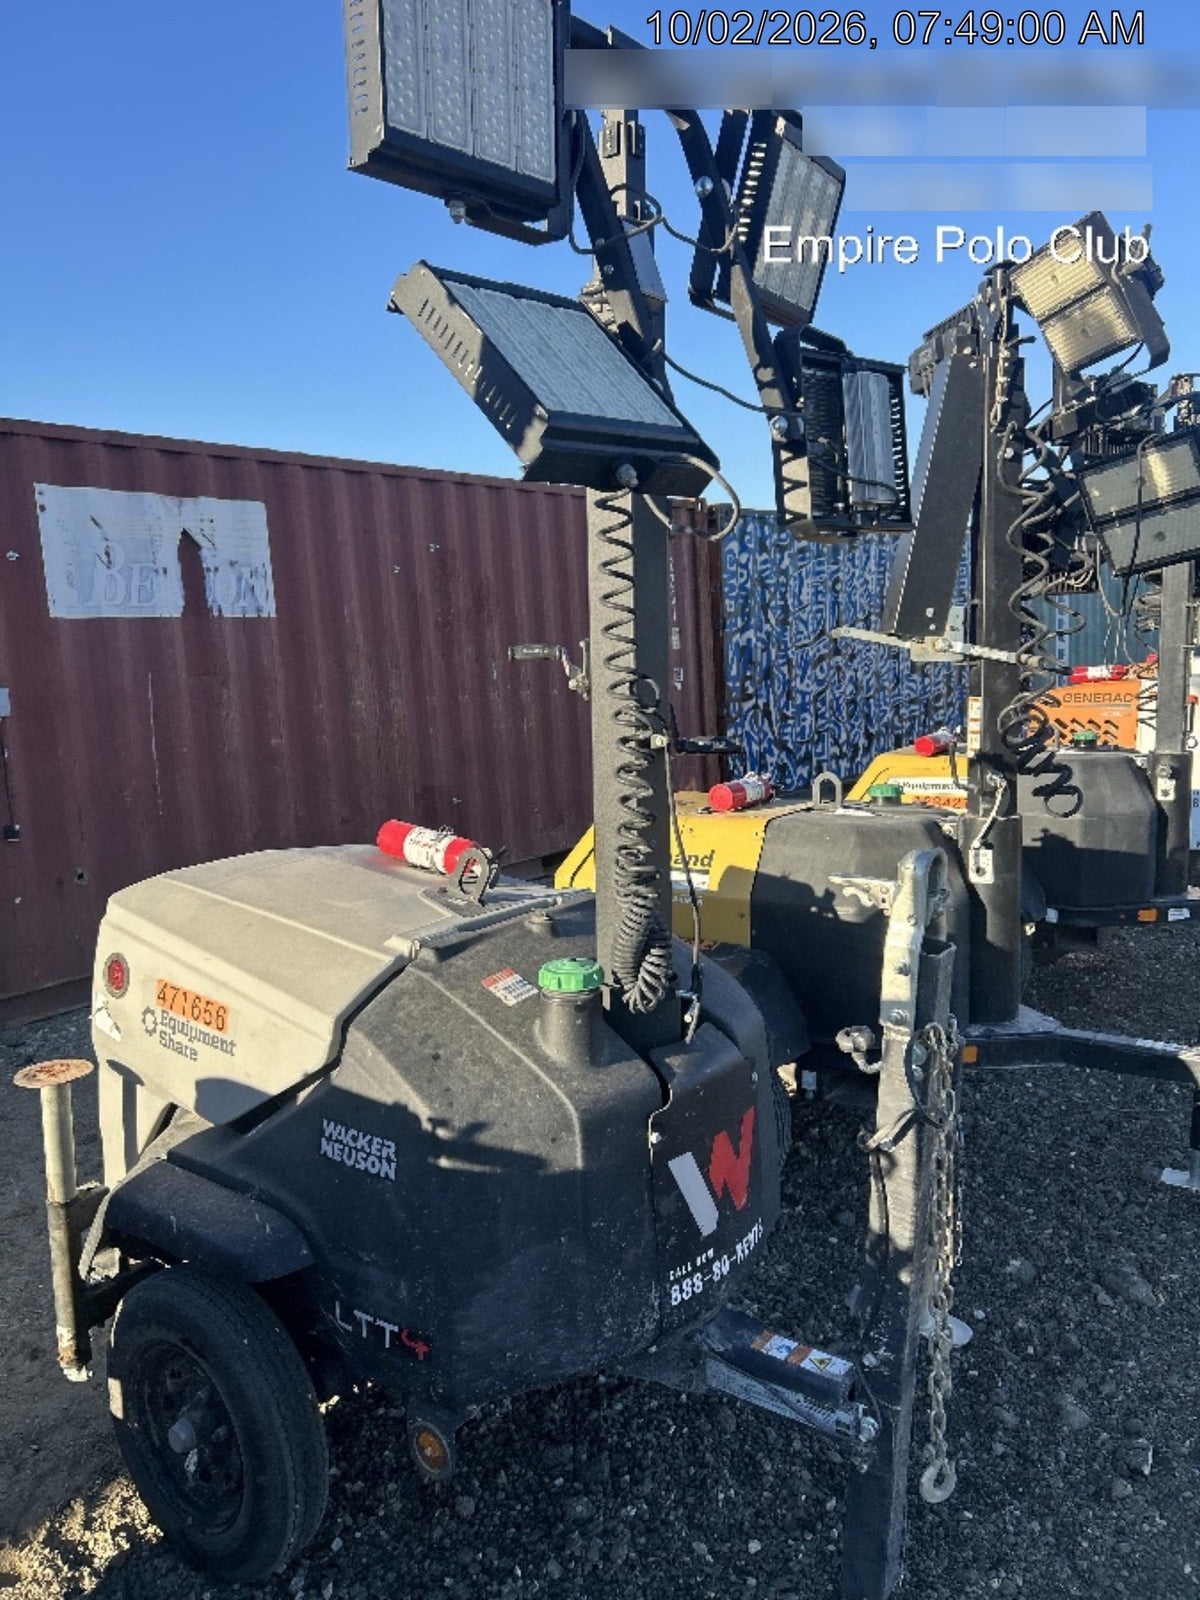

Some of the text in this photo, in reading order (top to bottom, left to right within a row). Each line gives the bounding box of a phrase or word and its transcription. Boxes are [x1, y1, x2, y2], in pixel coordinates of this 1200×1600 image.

[1062, 692, 1134, 703] GENERAC
[670, 849, 716, 869] and
[157, 982, 228, 1032] 471656
[159, 1030, 198, 1061] Share
[160, 1010, 237, 1057] Equipment
[320, 1137, 397, 1181] NEUSON
[322, 1118, 397, 1161] WACKER
